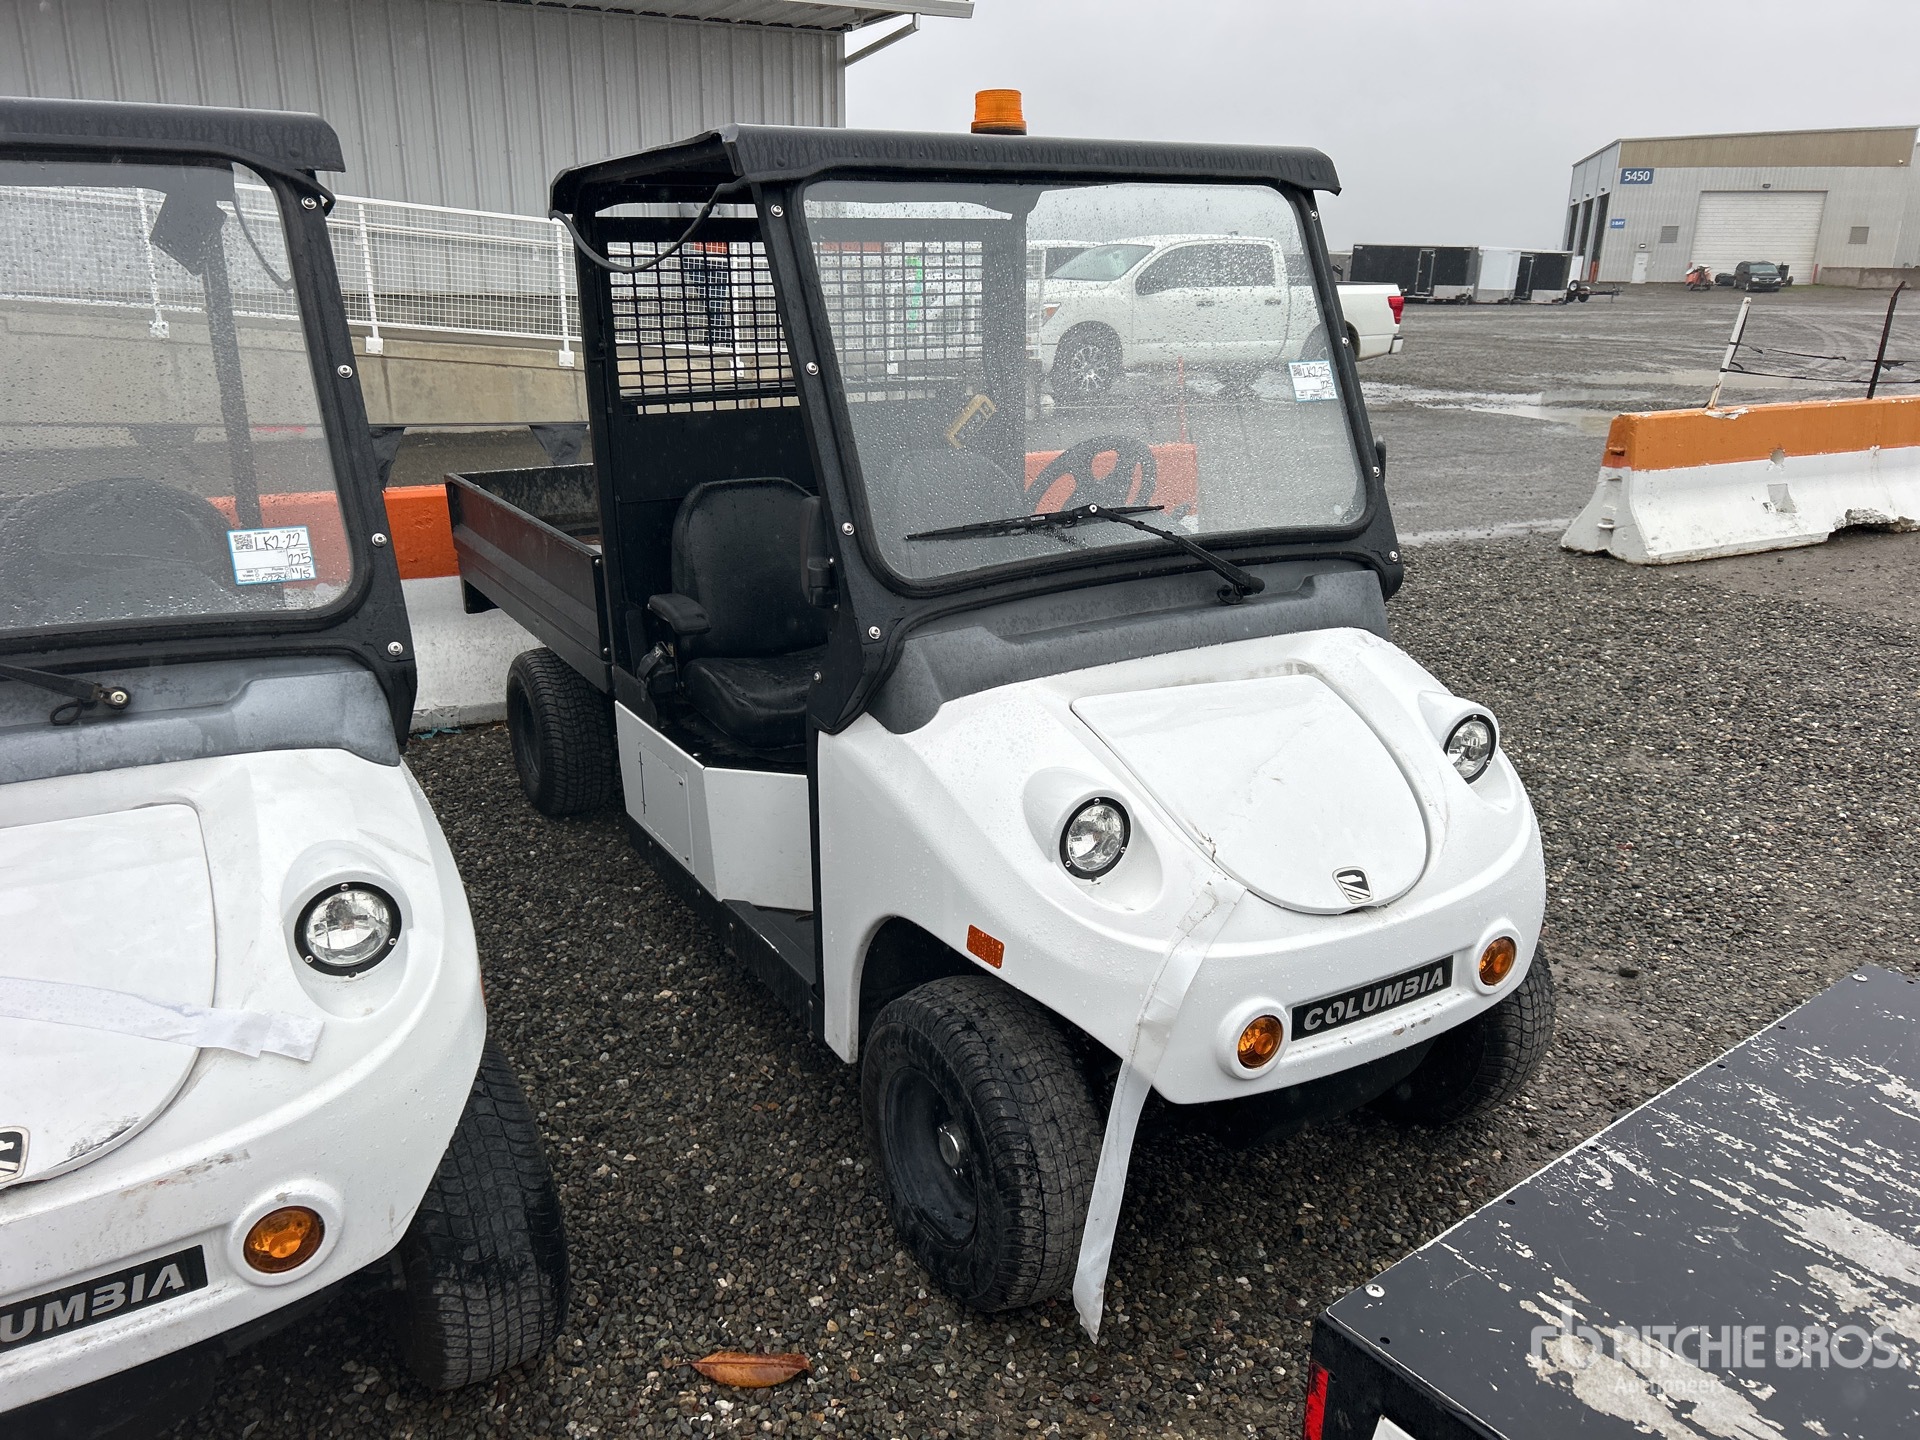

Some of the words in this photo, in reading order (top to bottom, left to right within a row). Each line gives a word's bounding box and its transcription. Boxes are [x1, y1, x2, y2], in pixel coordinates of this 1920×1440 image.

[1624, 170, 1650, 181] 5450
[1304, 967, 1443, 1031] COLUMBIA
[0, 1263, 185, 1343] UMBIA
